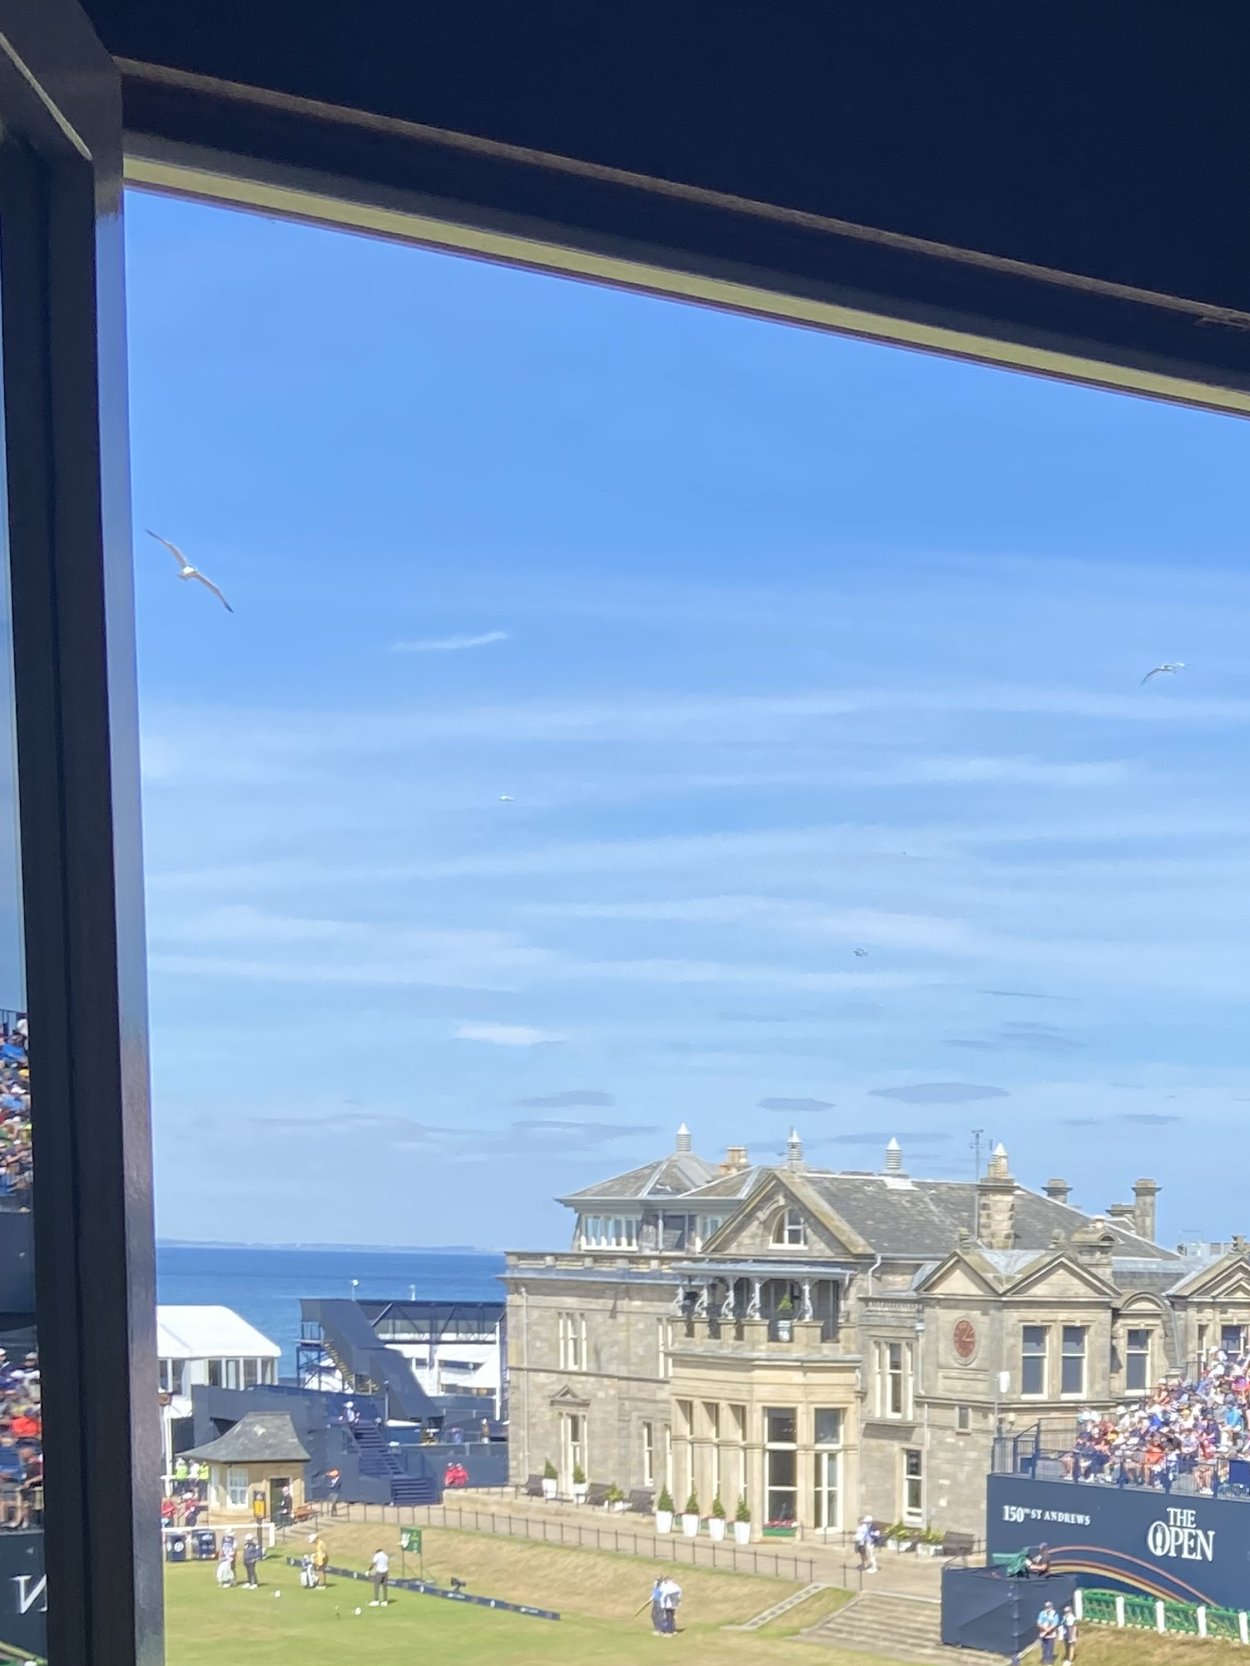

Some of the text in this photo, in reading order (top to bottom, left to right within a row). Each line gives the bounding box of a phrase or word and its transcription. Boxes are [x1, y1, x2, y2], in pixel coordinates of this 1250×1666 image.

[1043, 1510, 1091, 1526] ANDREWS
[1166, 1507, 1197, 1528] THE
[1147, 1520, 1216, 1562] OPEN
